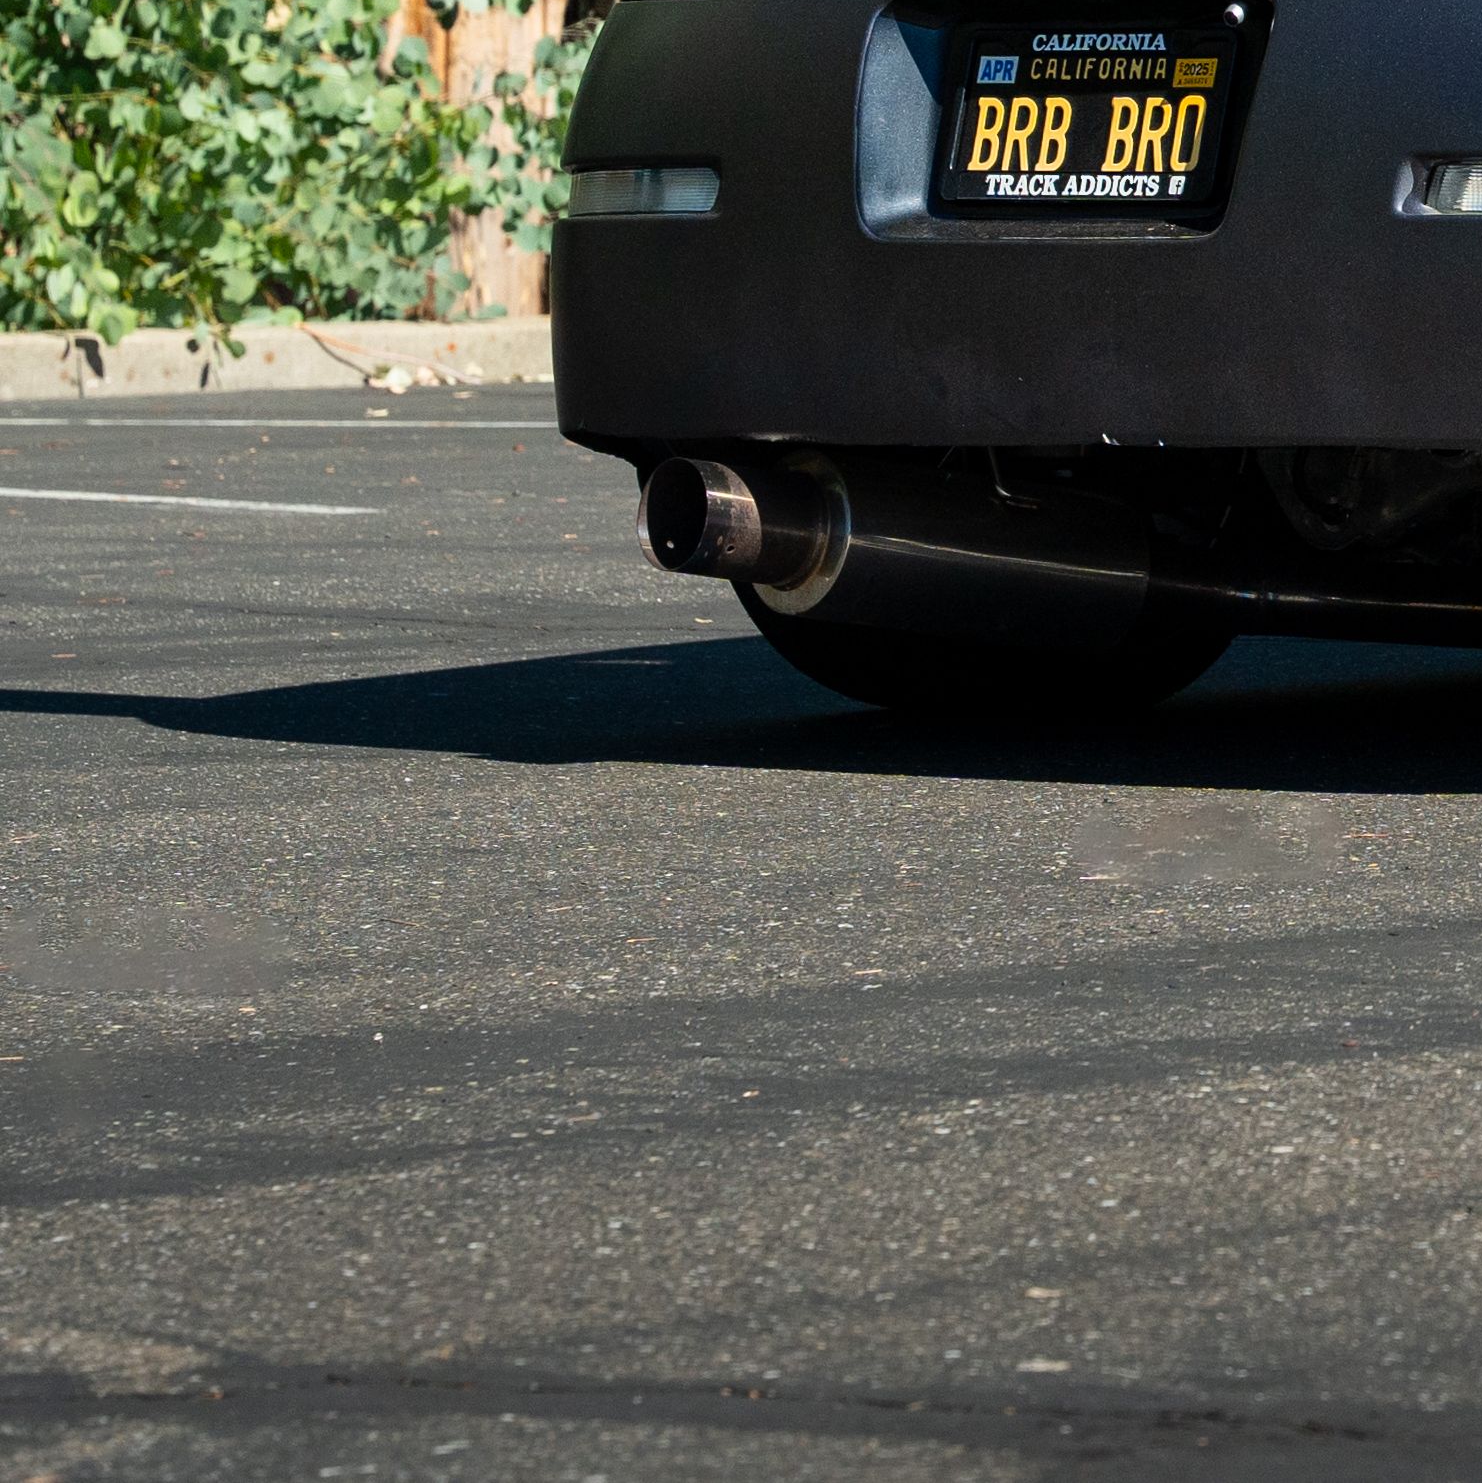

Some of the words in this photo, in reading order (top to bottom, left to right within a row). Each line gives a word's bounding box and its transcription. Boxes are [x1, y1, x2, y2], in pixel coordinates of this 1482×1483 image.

[1032, 33, 1167, 52] CALIFORNIA
[980, 59, 1015, 81] APR
[1030, 57, 1167, 81] CALIFORNIA
[1182, 62, 1210, 77] 2025
[967, 96, 1073, 172] BRB
[985, 173, 1059, 197] TRACK
[1061, 173, 1160, 197] ADDICTS
